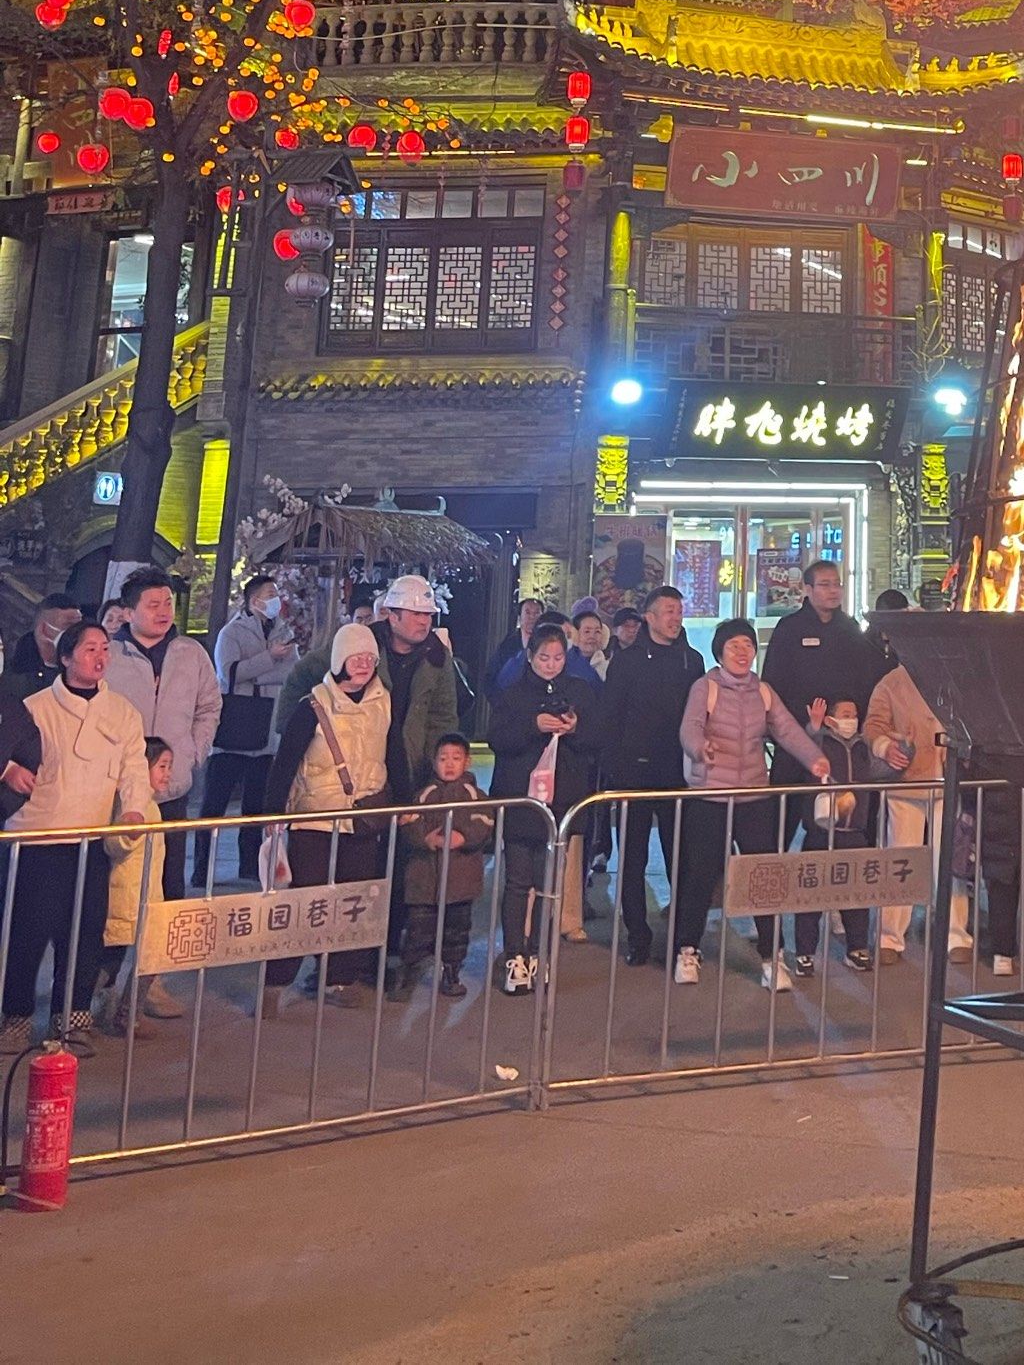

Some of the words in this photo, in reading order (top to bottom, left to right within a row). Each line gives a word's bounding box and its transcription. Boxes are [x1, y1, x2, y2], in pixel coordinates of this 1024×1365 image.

[691, 151, 879, 206] 小四川
[798, 859, 913, 888] 福园巷子
[227, 895, 366, 937] 福园巷子
